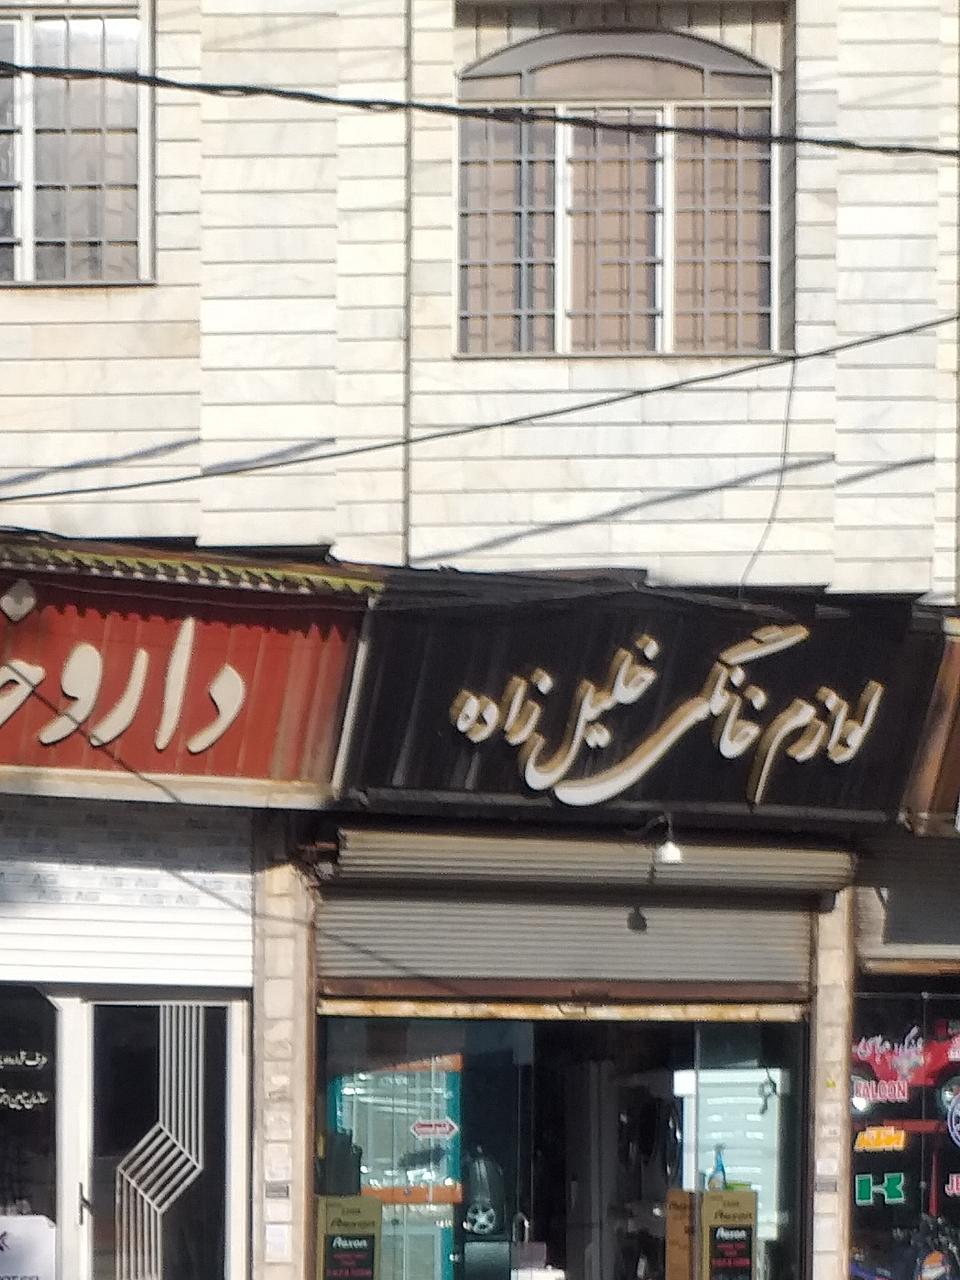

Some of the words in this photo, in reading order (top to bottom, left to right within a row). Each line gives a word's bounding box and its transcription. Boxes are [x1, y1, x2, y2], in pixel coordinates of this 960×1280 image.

[449, 666, 555, 747] زاده
[518, 632, 662, 791] خلیل
[552, 622, 812, 807] خانگی
[746, 678, 886, 807] لوازم
